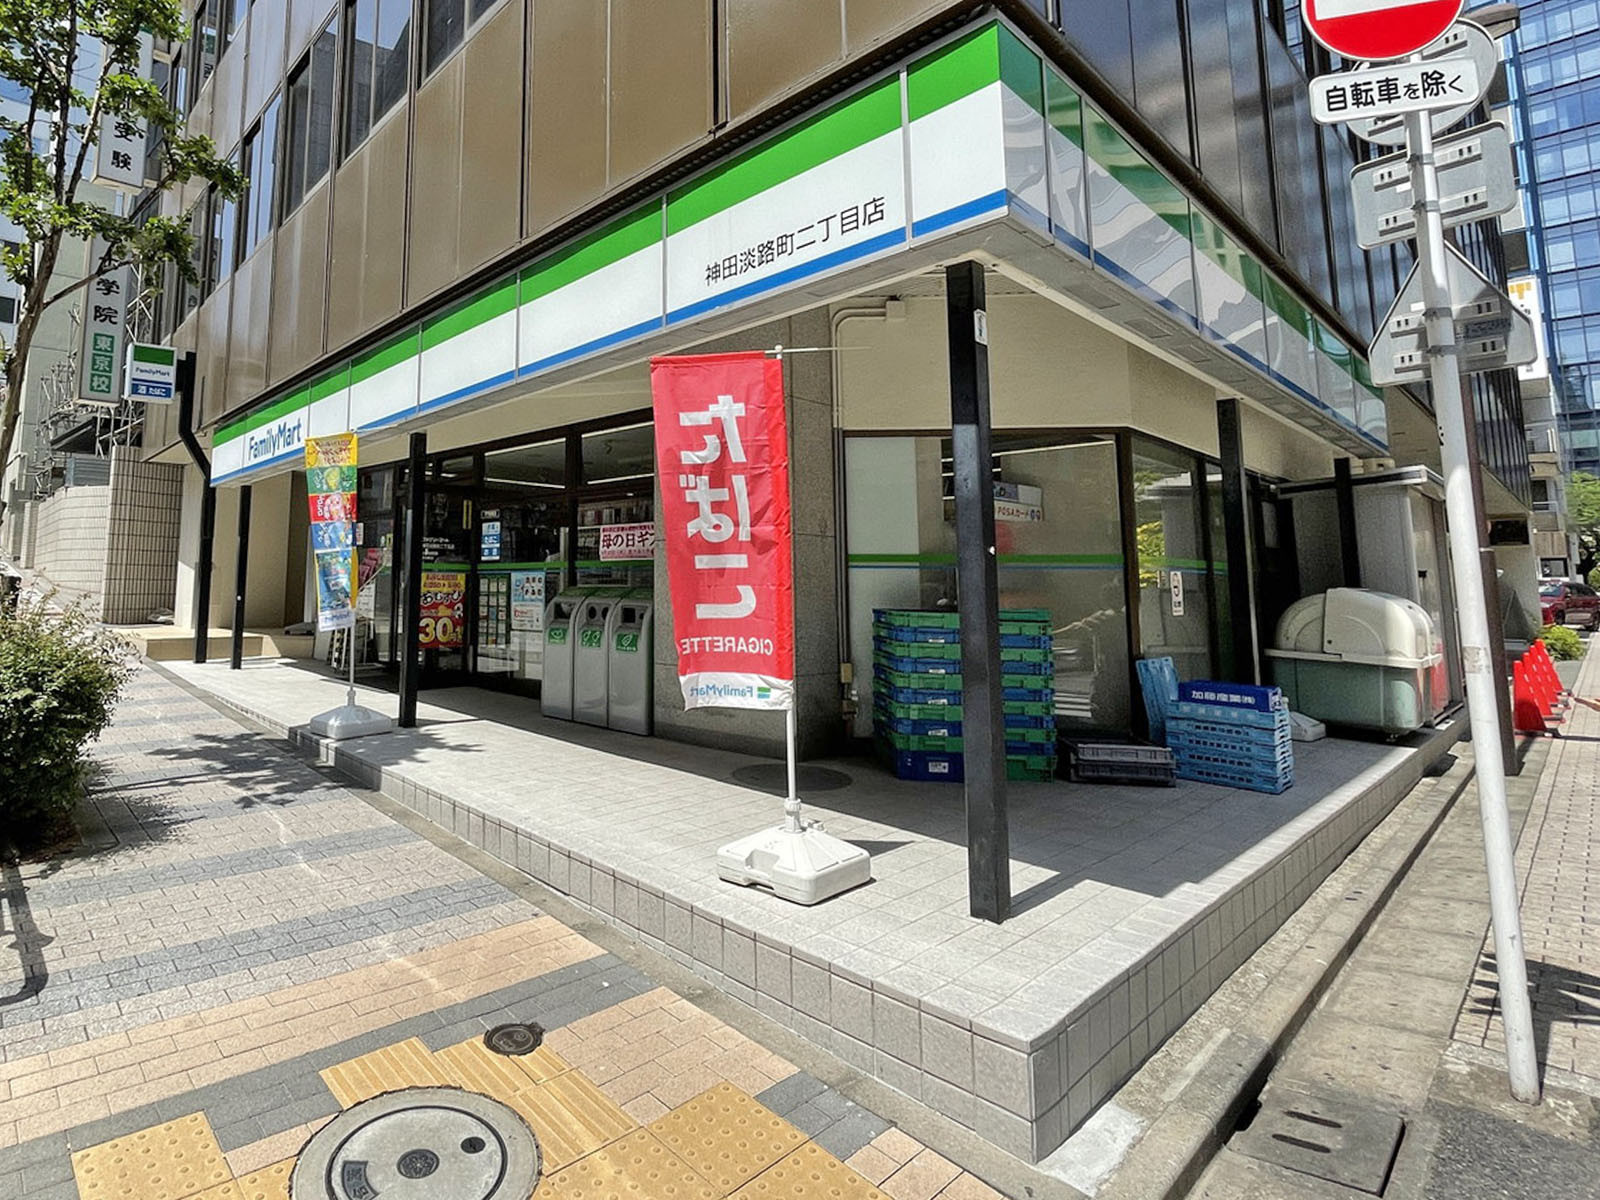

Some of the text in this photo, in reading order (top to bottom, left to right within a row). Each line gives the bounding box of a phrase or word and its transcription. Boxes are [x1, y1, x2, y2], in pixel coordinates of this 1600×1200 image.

[1325, 71, 1463, 112] 自転車を除く
[705, 196, 885, 287] 神田淡路町二丁目店
[92, 335, 113, 394] 東京校
[135, 366, 171, 378] FamilyMart
[248, 417, 302, 460] FamilyMart
